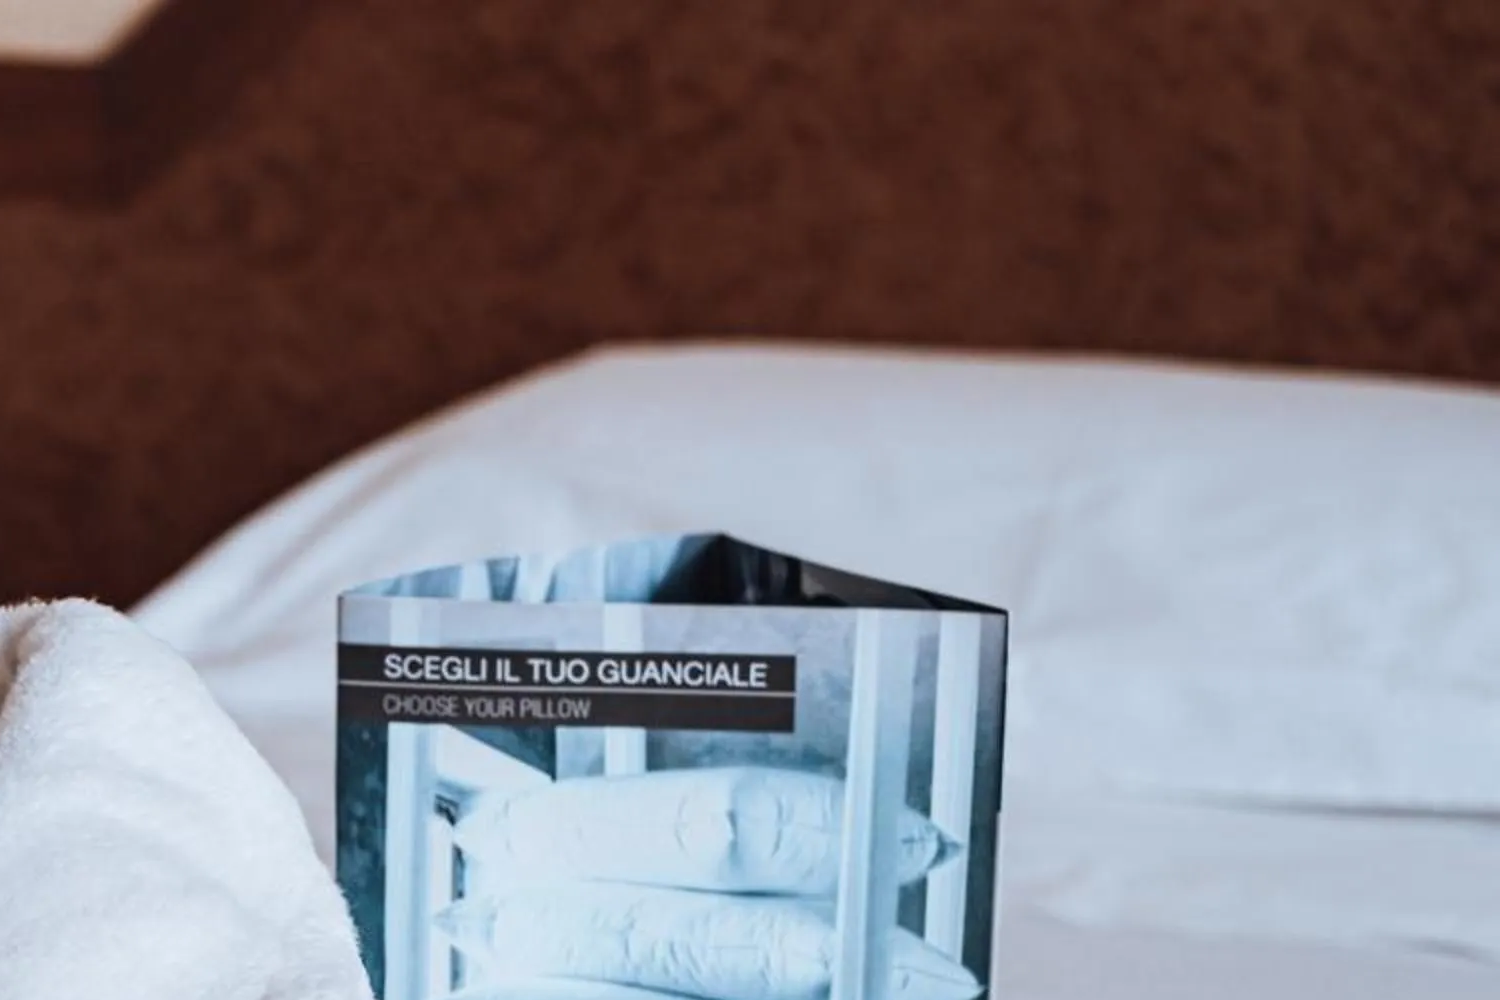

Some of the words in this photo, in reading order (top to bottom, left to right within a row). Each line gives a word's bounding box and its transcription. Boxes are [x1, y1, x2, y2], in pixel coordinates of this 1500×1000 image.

[383, 654, 487, 682] SCEGLI
[496, 657, 520, 683] IL
[527, 657, 590, 684] TUO
[597, 660, 767, 688] GUANCIALE
[382, 694, 459, 717] CHOOSE
[464, 697, 514, 718] YOUR
[519, 698, 591, 719] PILLOW
